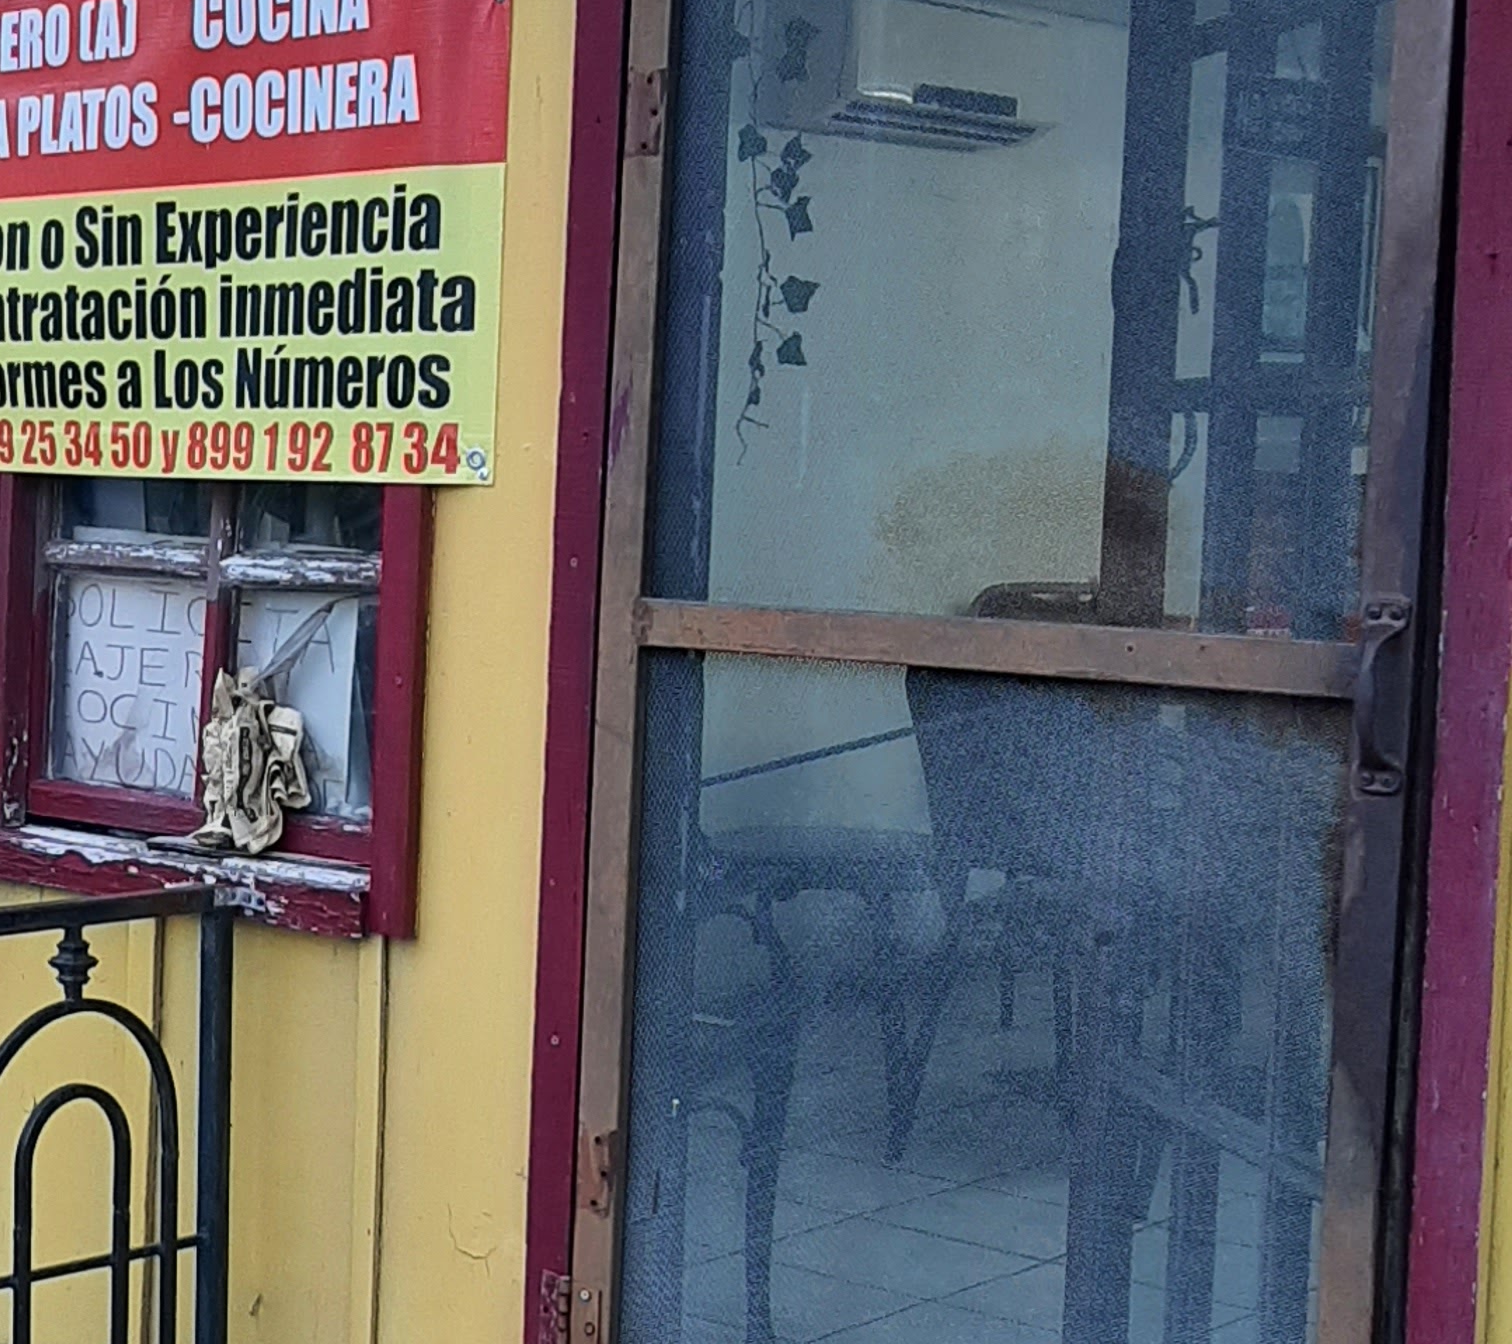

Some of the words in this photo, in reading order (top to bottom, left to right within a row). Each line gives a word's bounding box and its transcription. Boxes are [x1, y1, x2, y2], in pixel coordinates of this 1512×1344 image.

[17, 80, 158, 157] PLATOS
[173, 54, 421, 144] -COCINERA
[40, 218, 65, 270] o
[75, 204, 143, 269] Sin
[155, 183, 442, 269] Experiencia
[219, 266, 476, 338] inmediata
[117, 359, 142, 410] a
[153, 349, 224, 410] Los
[235, 344, 451, 410] Números
[161, 428, 180, 474] y
[187, 420, 255, 471] 899
